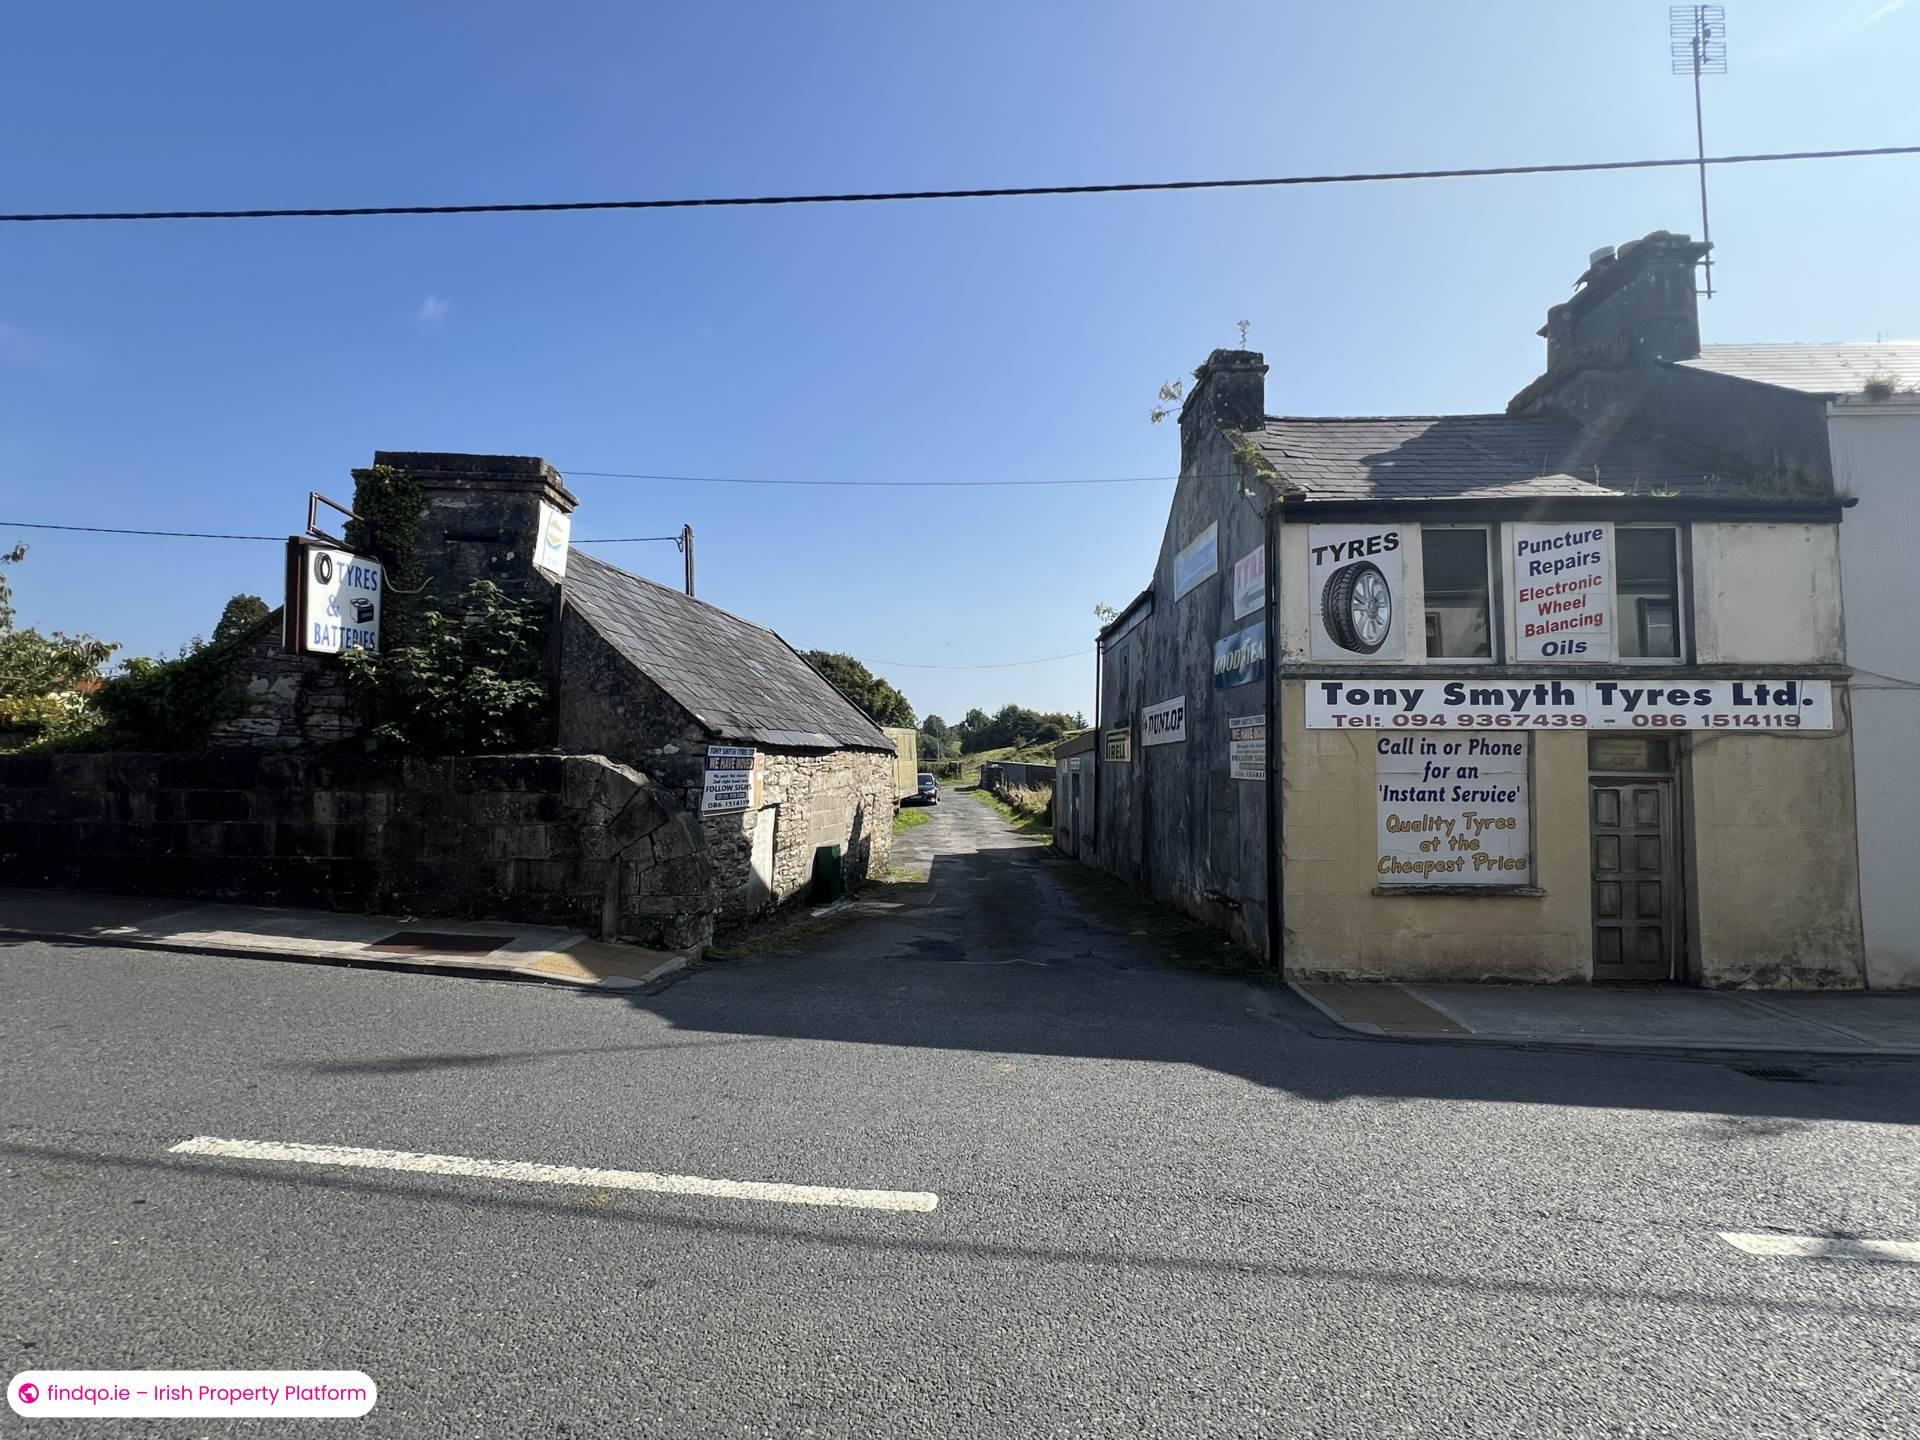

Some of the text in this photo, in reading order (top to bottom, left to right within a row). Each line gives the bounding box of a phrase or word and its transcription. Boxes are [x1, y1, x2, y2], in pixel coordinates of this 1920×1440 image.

[1312, 532, 1399, 566] TYRES
[1518, 528, 1603, 556] Puncture
[1235, 546, 1265, 594] TYRE
[1529, 551, 1601, 576] Repairs
[336, 562, 378, 591] TYRES
[1519, 574, 1602, 602] Electronic
[327, 594, 340, 617] &
[1537, 594, 1587, 616] Wheel
[313, 622, 375, 651] BATTERIES
[1525, 613, 1603, 637] Balancing
[1215, 637, 1266, 675] GOODYEA
[1541, 639, 1588, 657] Oils
[1321, 681, 1814, 712] Tony Smyth Tyres Ltd.
[1148, 707, 1184, 735] DUNLOP
[1332, 714, 1381, 727] Tel:
[1392, 714, 1447, 727] 094
[1457, 714, 1587, 727] 9367439
[1631, 714, 1687, 727] 086
[1701, 714, 1800, 727] 1514119
[1377, 737, 1522, 756] Call in or Phone
[709, 757, 754, 770] WE HAVE MOVED
[1423, 761, 1479, 783] for an
[1379, 784, 1521, 803] 'Instant Service'
[1386, 812, 1517, 837] Quality Tyres
[1420, 833, 1480, 852] at the
[1377, 852, 1527, 879] Cheapest Price
